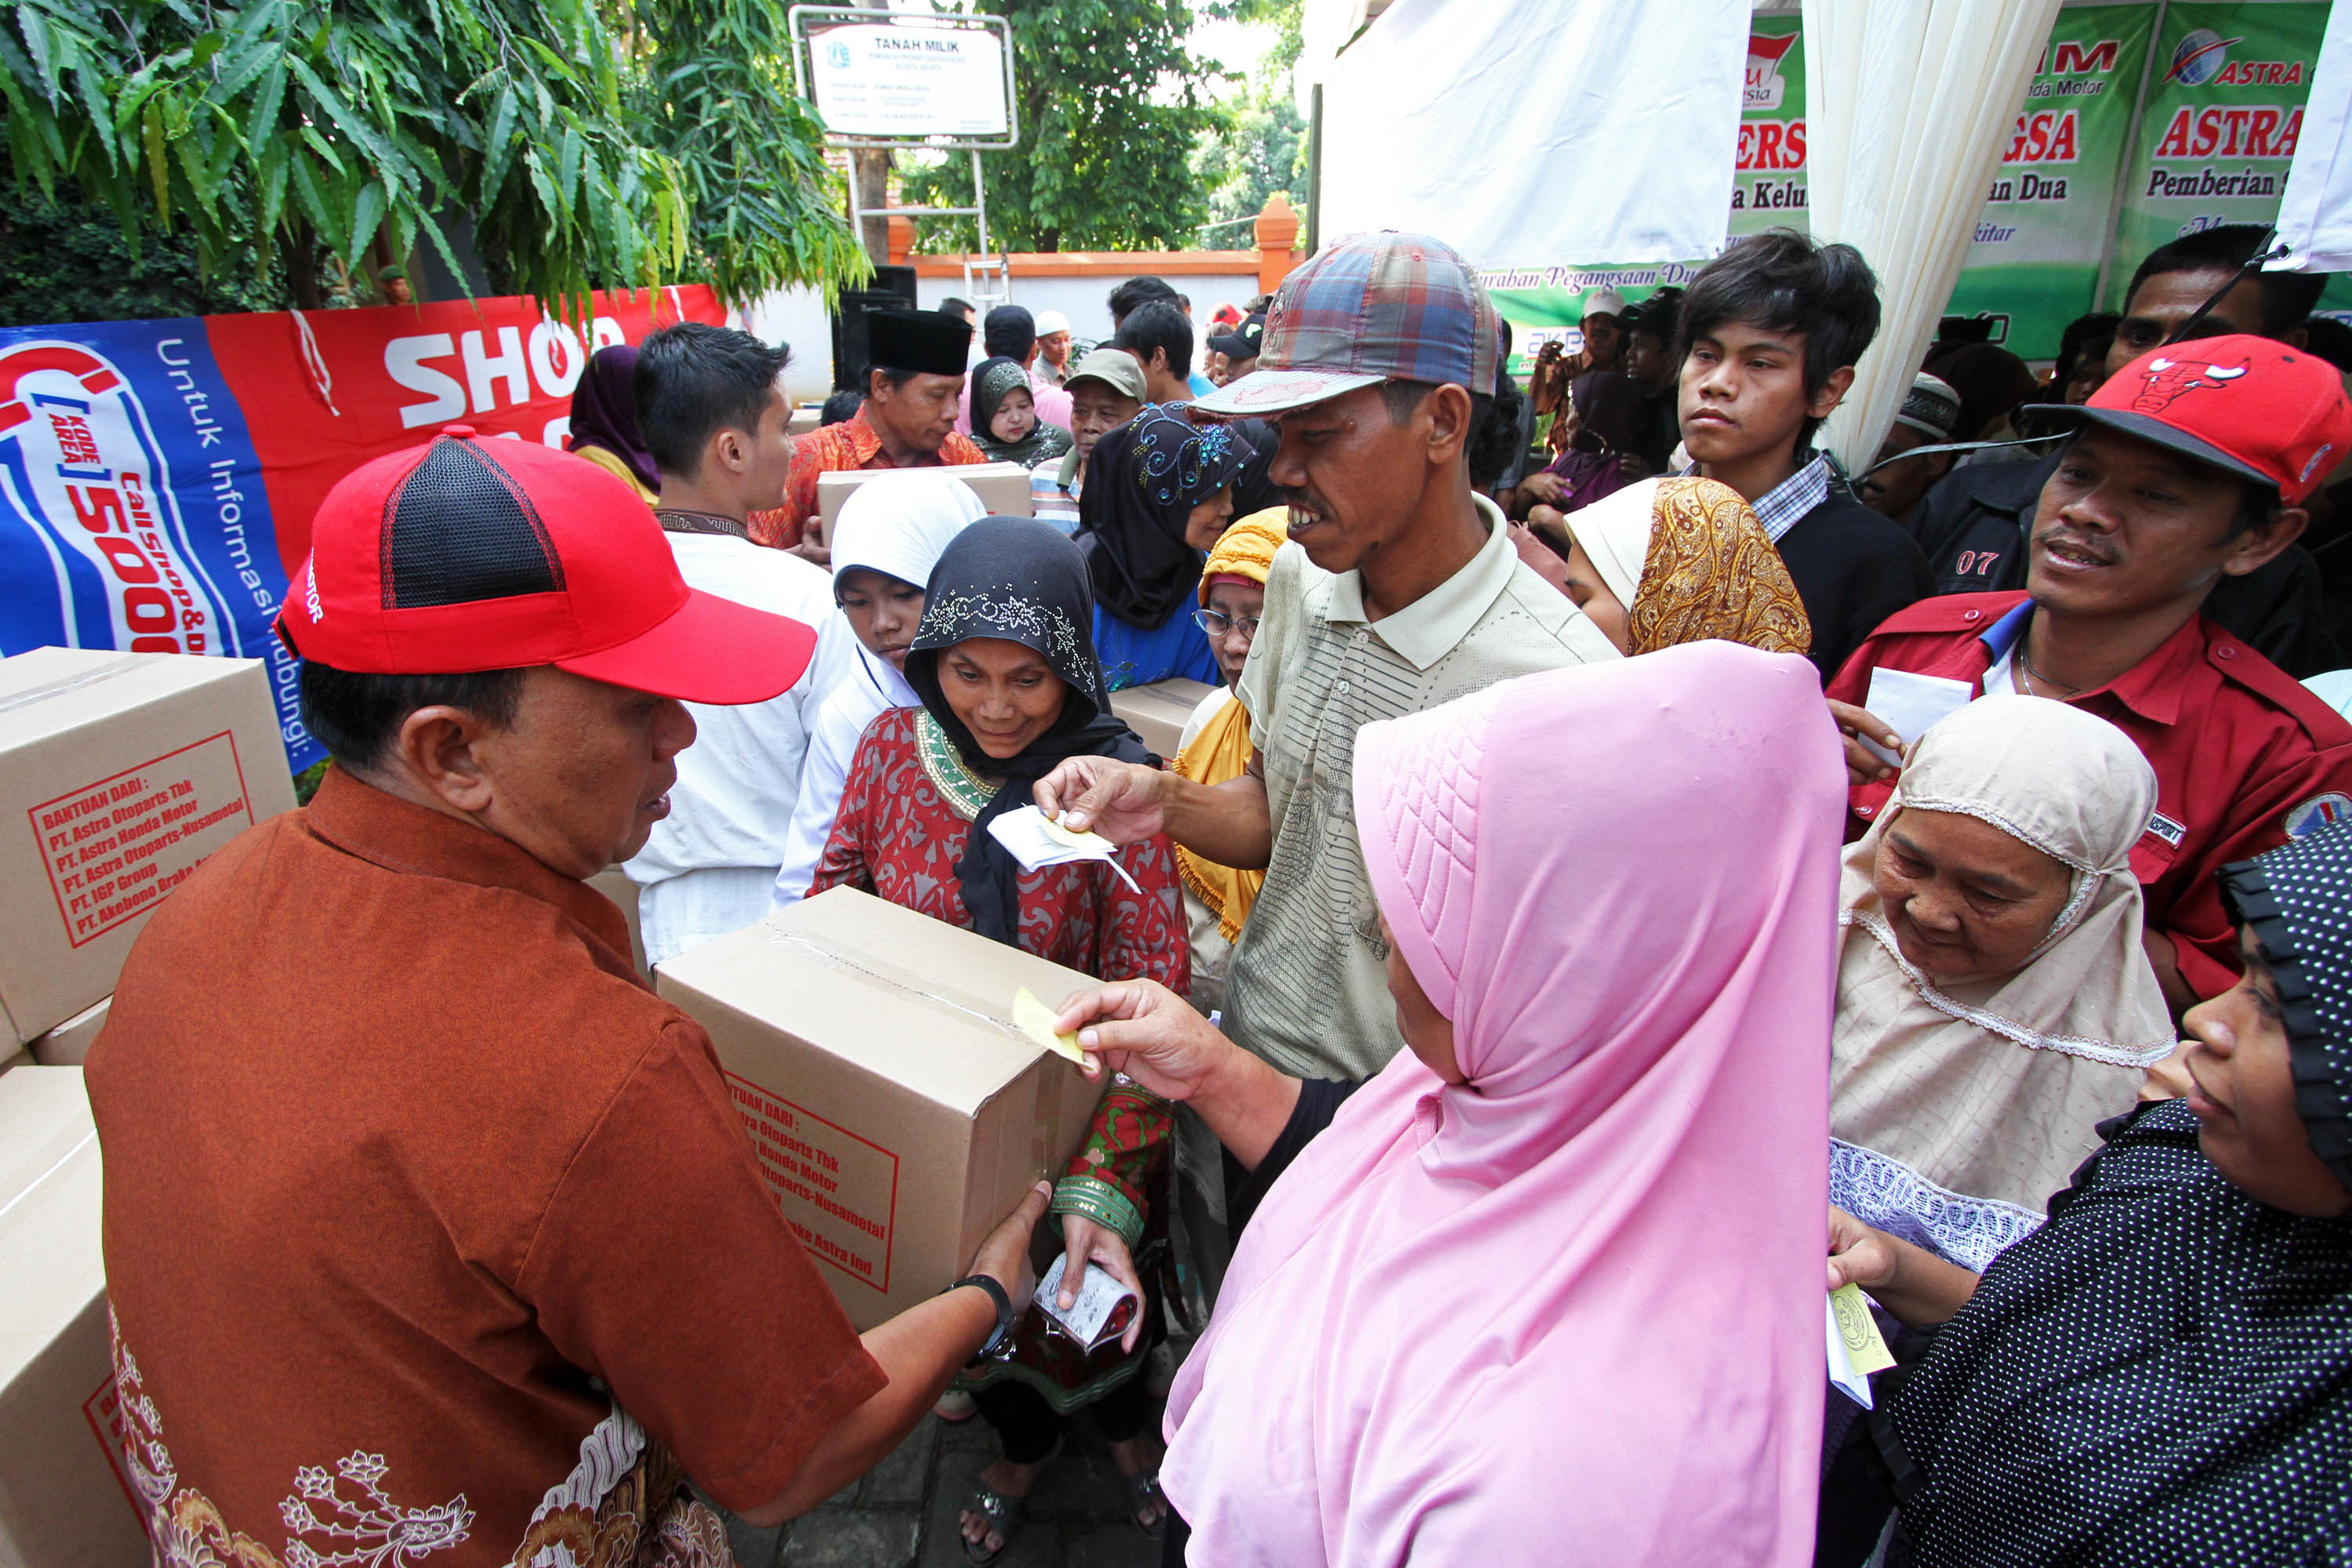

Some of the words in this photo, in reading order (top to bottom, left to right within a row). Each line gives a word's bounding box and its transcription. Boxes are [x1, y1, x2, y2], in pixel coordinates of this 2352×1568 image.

[875, 38, 920, 51] TANAH
[925, 39, 959, 53] MILIK
[2056, 81, 2104, 96] Motor
[2214, 63, 2302, 85] ASTRA
[2156, 109, 2304, 156] ASTRA
[1752, 181, 1809, 209] Kelu
[2019, 174, 2067, 201] Dua
[2147, 169, 2274, 196] Pemberian
[1479, 269, 1539, 289] urahan
[1545, 267, 1656, 293] Pegangsaan
[49, 413, 78, 464] AREA
[67, 415, 101, 465] KODE
[121, 471, 155, 528] Call
[157, 338, 223, 448] Untuk
[210, 459, 283, 617] Informasi
[1956, 550, 1999, 575] 07
[42, 791, 110, 830] BANTUAN
[110, 778, 143, 802] DARI
[49, 831, 72, 852] PT.
[73, 816, 111, 843] Astra
[111, 791, 169, 824] Otoparts
[169, 780, 194, 800] Tbk
[56, 852, 78, 873] PT.
[79, 837, 118, 864] Astra
[118, 817, 162, 845] Honda
[161, 799, 198, 825] Motor
[63, 873, 85, 894] PT.
[85, 857, 123, 884] Astra
[124, 797, 244, 864] Otoparts-Nusametal
[70, 894, 92, 915] PT.
[92, 881, 114, 904] IGP
[117, 862, 158, 891] Group
[76, 914, 98, 935] PT.
[99, 885, 156, 924] Akebono
[157, 866, 194, 892] Brake
[764, 1102, 793, 1129] DARI
[759, 1142, 798, 1173] Honda
[800, 1163, 838, 1193] Motor
[760, 1121, 813, 1160] Otoparts
[815, 1149, 839, 1174] Tbk
[815, 1233, 848, 1264] Astra
[851, 1253, 873, 1276] Ind
